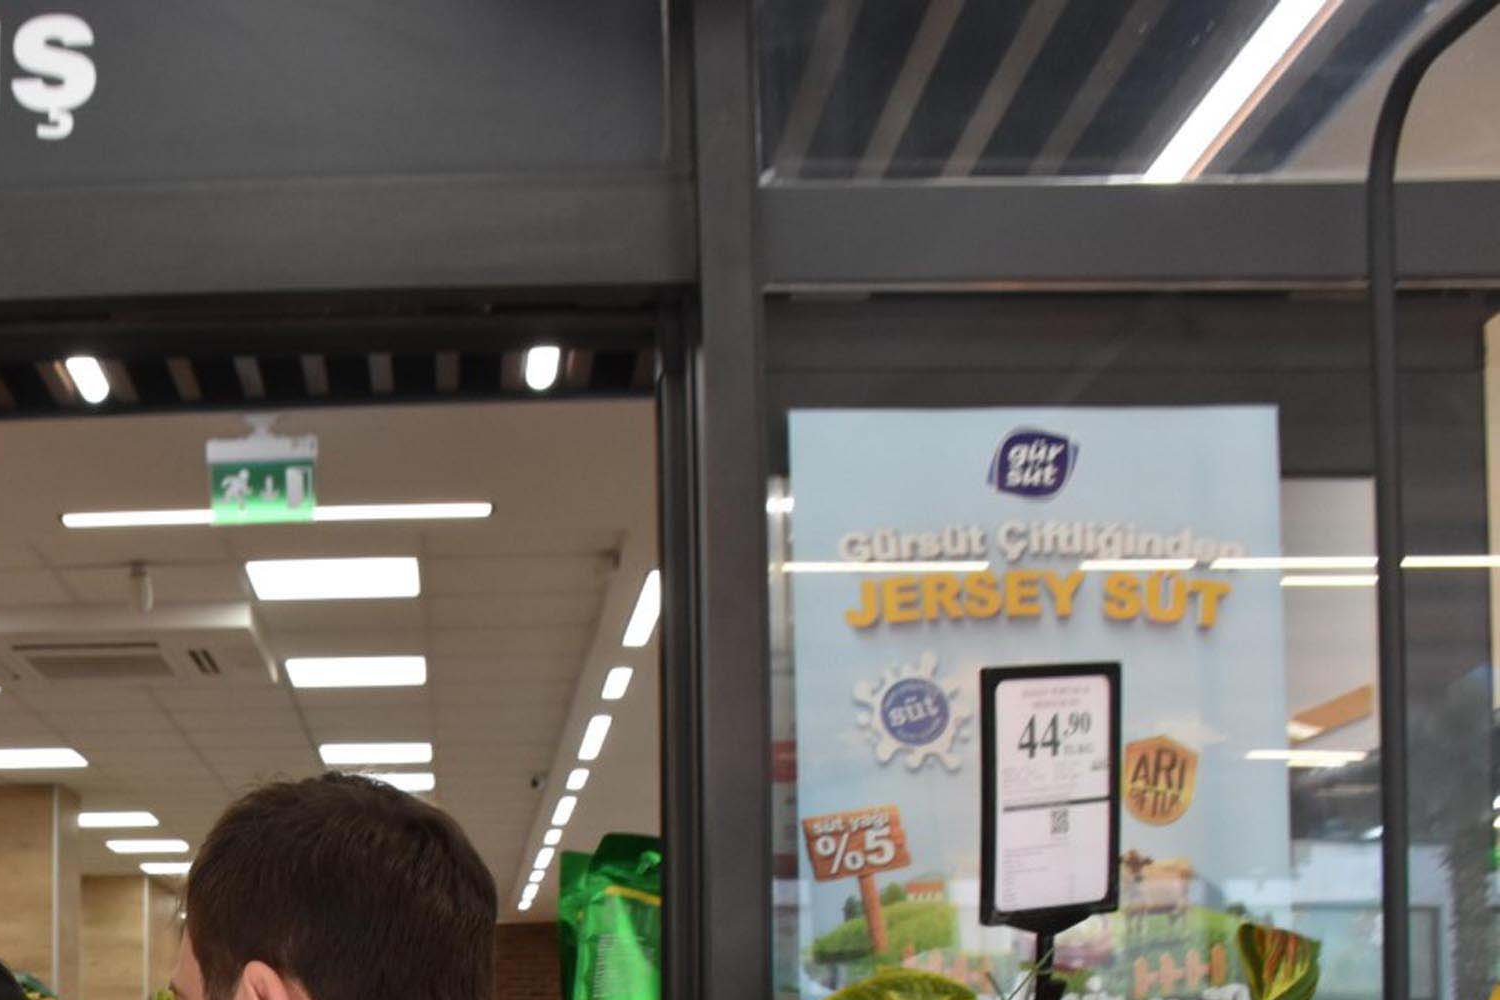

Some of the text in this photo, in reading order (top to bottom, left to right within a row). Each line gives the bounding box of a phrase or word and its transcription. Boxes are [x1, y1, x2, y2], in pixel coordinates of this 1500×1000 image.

[1007, 438, 1066, 468] gür
[838, 524, 989, 563] Gürsüt
[845, 569, 1232, 629] JERSEY SÜT
[814, 825, 897, 875] %5
